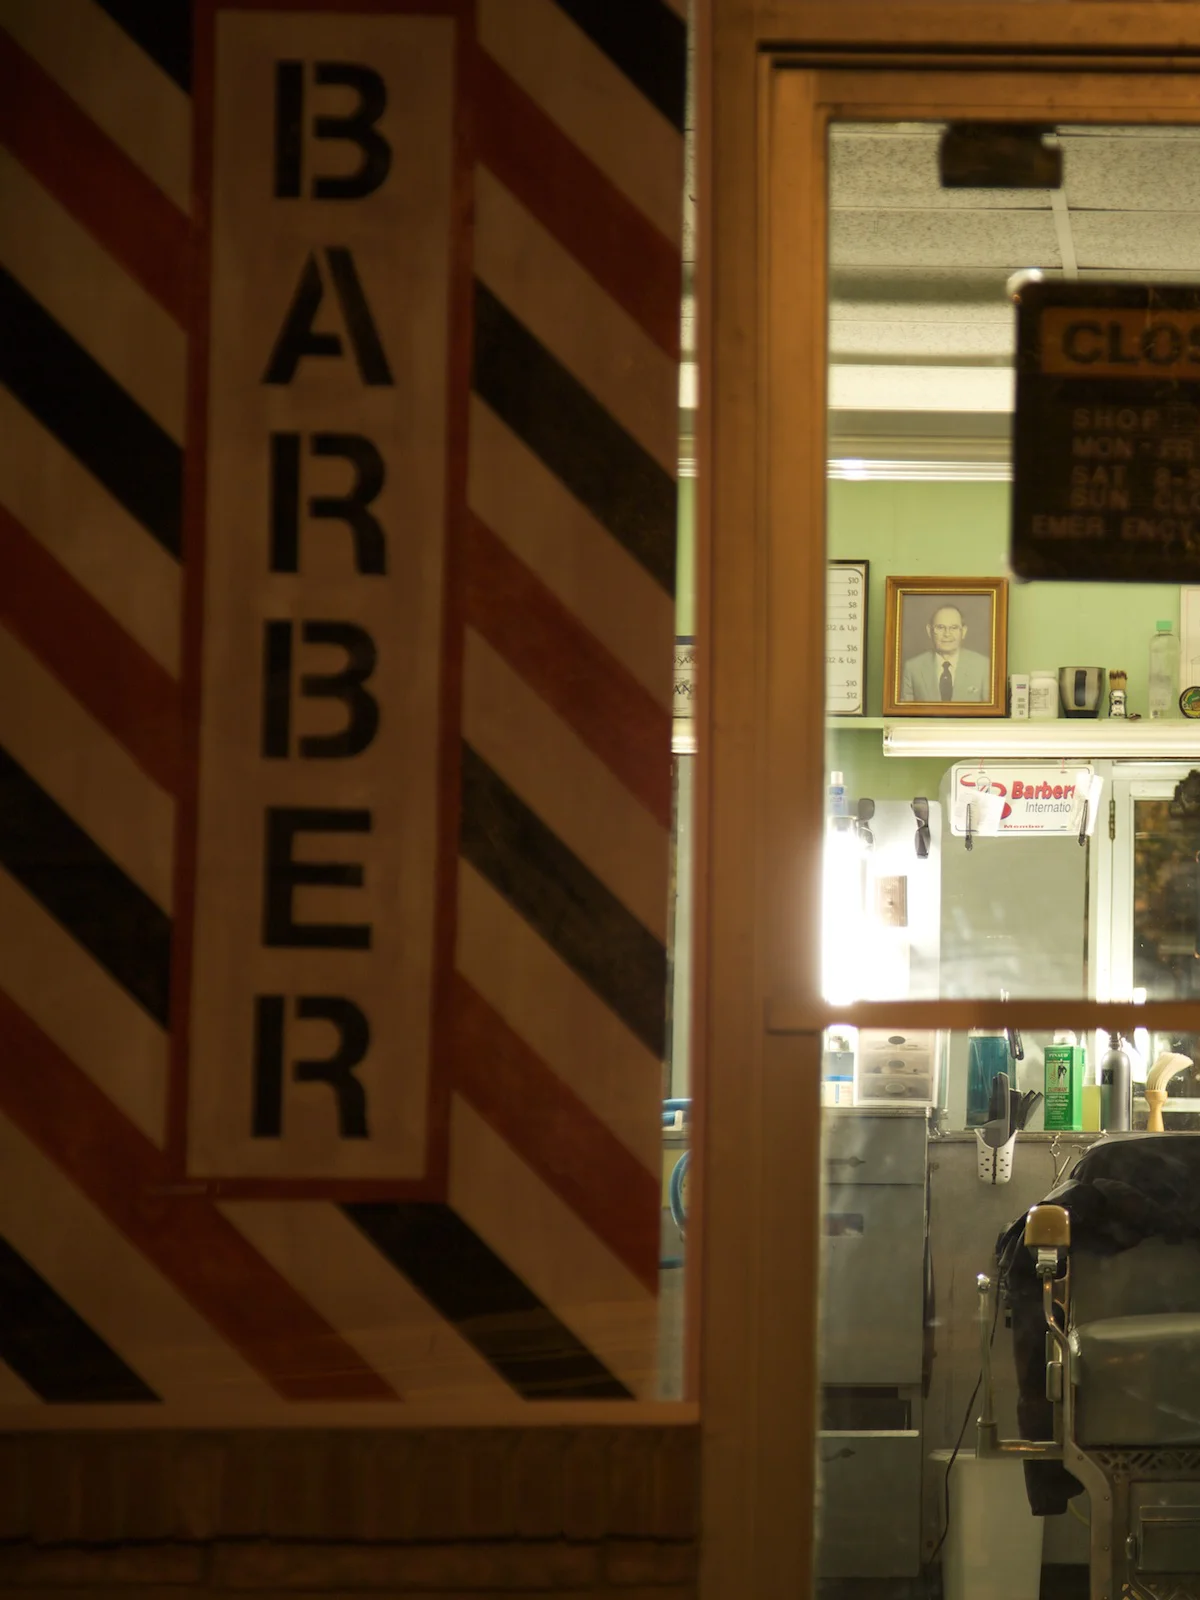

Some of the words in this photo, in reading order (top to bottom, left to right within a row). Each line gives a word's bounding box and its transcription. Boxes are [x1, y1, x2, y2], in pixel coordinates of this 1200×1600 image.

[1072, 408, 1159, 431] SHOP
[1072, 437, 1134, 460] MON
[1071, 465, 1128, 487] SAT
[1070, 487, 1130, 509] SUN
[251, 58, 396, 1141] BARBER
[1025, 801, 1072, 813] Internatio
